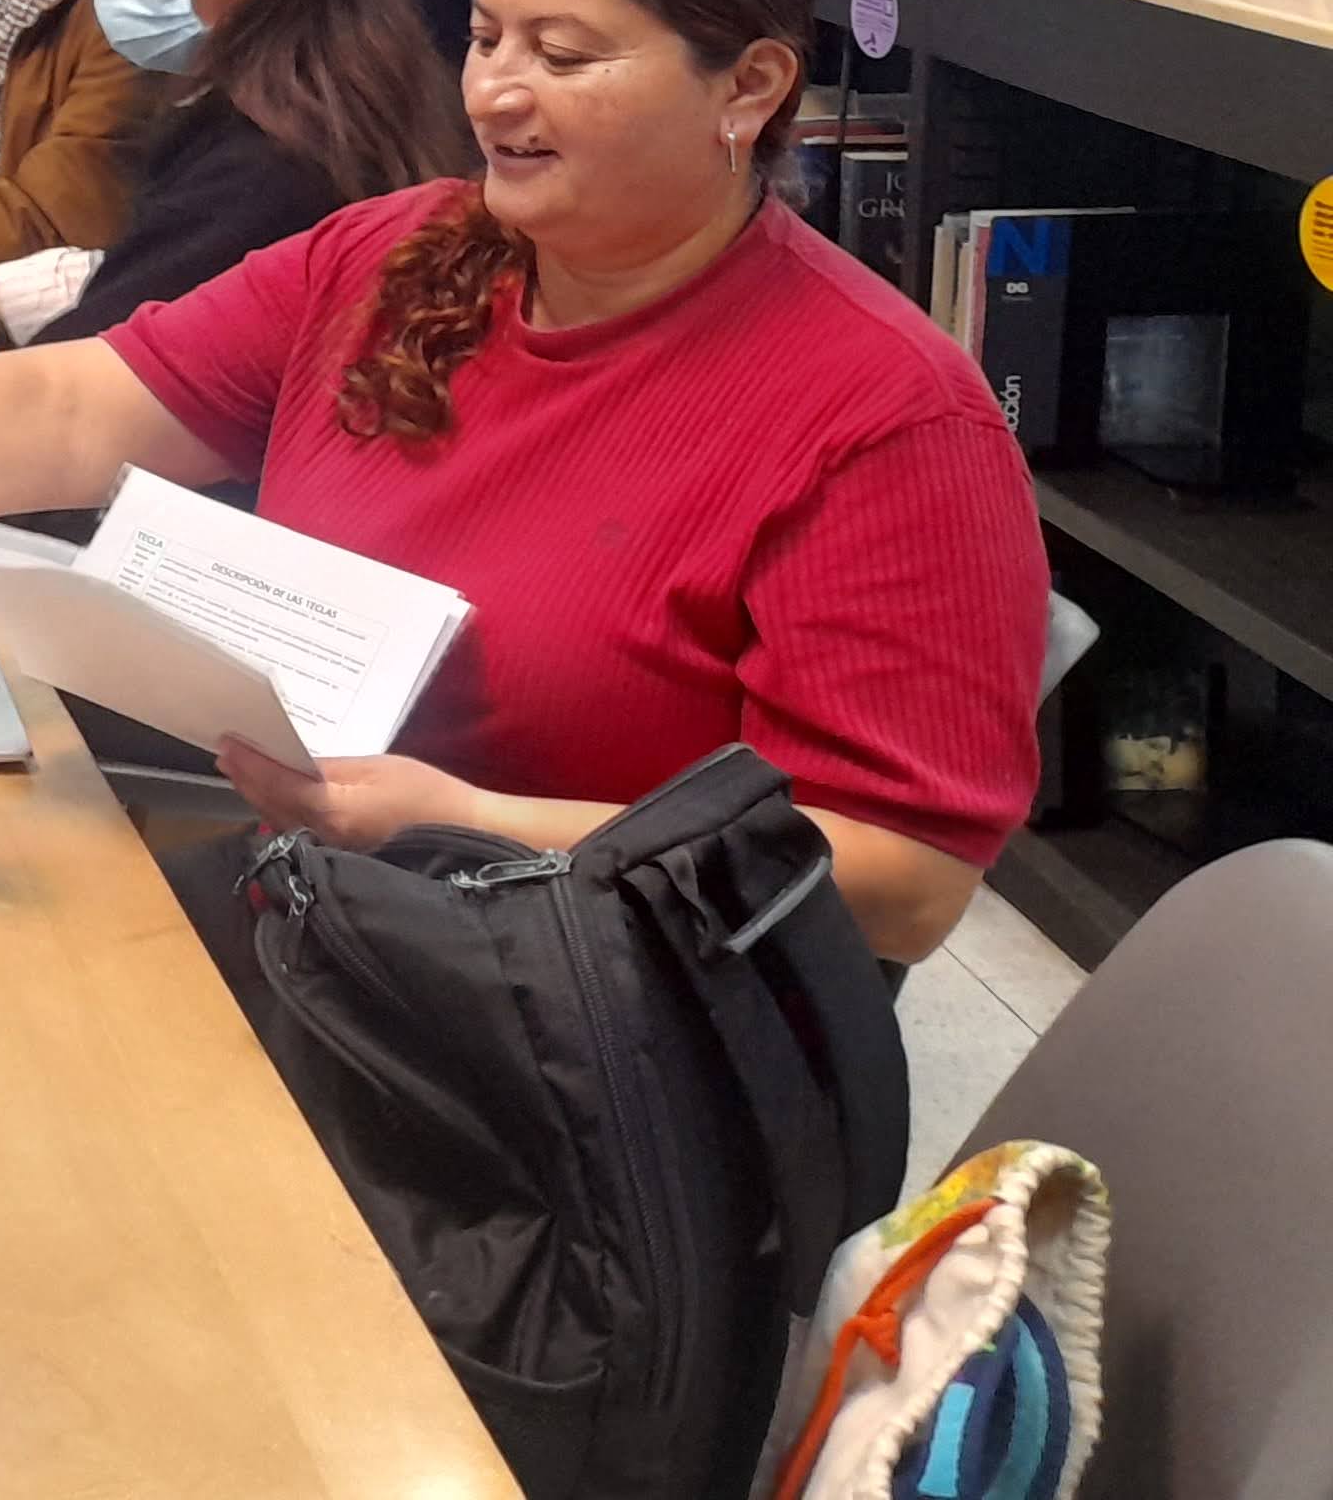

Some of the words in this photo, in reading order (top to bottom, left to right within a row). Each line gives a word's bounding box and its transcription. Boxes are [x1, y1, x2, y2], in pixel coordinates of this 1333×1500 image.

[137, 531, 164, 549] TECLA
[211, 562, 271, 593] DESCRIPCIÓN
[272, 587, 285, 598] DE
[286, 592, 304, 606] LAS
[305, 599, 338, 619] TECLAS
